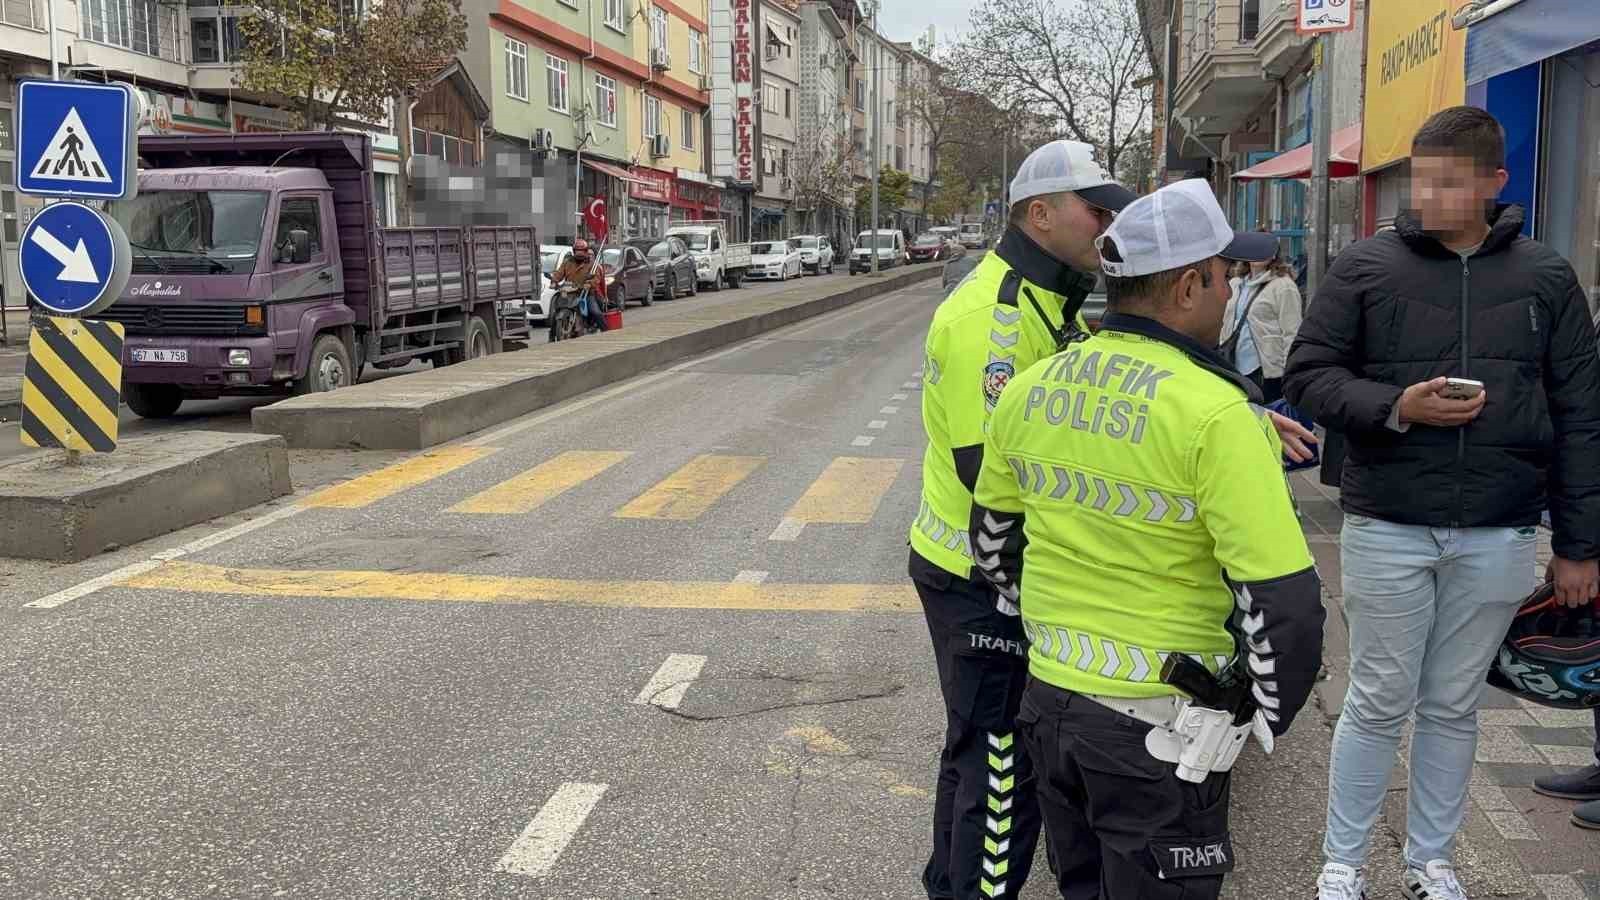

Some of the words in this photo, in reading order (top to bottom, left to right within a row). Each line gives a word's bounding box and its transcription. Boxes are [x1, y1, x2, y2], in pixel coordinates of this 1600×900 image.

[735, 0, 751, 83] BALKAN
[1381, 34, 1405, 87] RAKİP
[1405, 9, 1447, 72] MARKET
[738, 97, 751, 181] PALACE
[967, 632, 1023, 656] TRAFI
